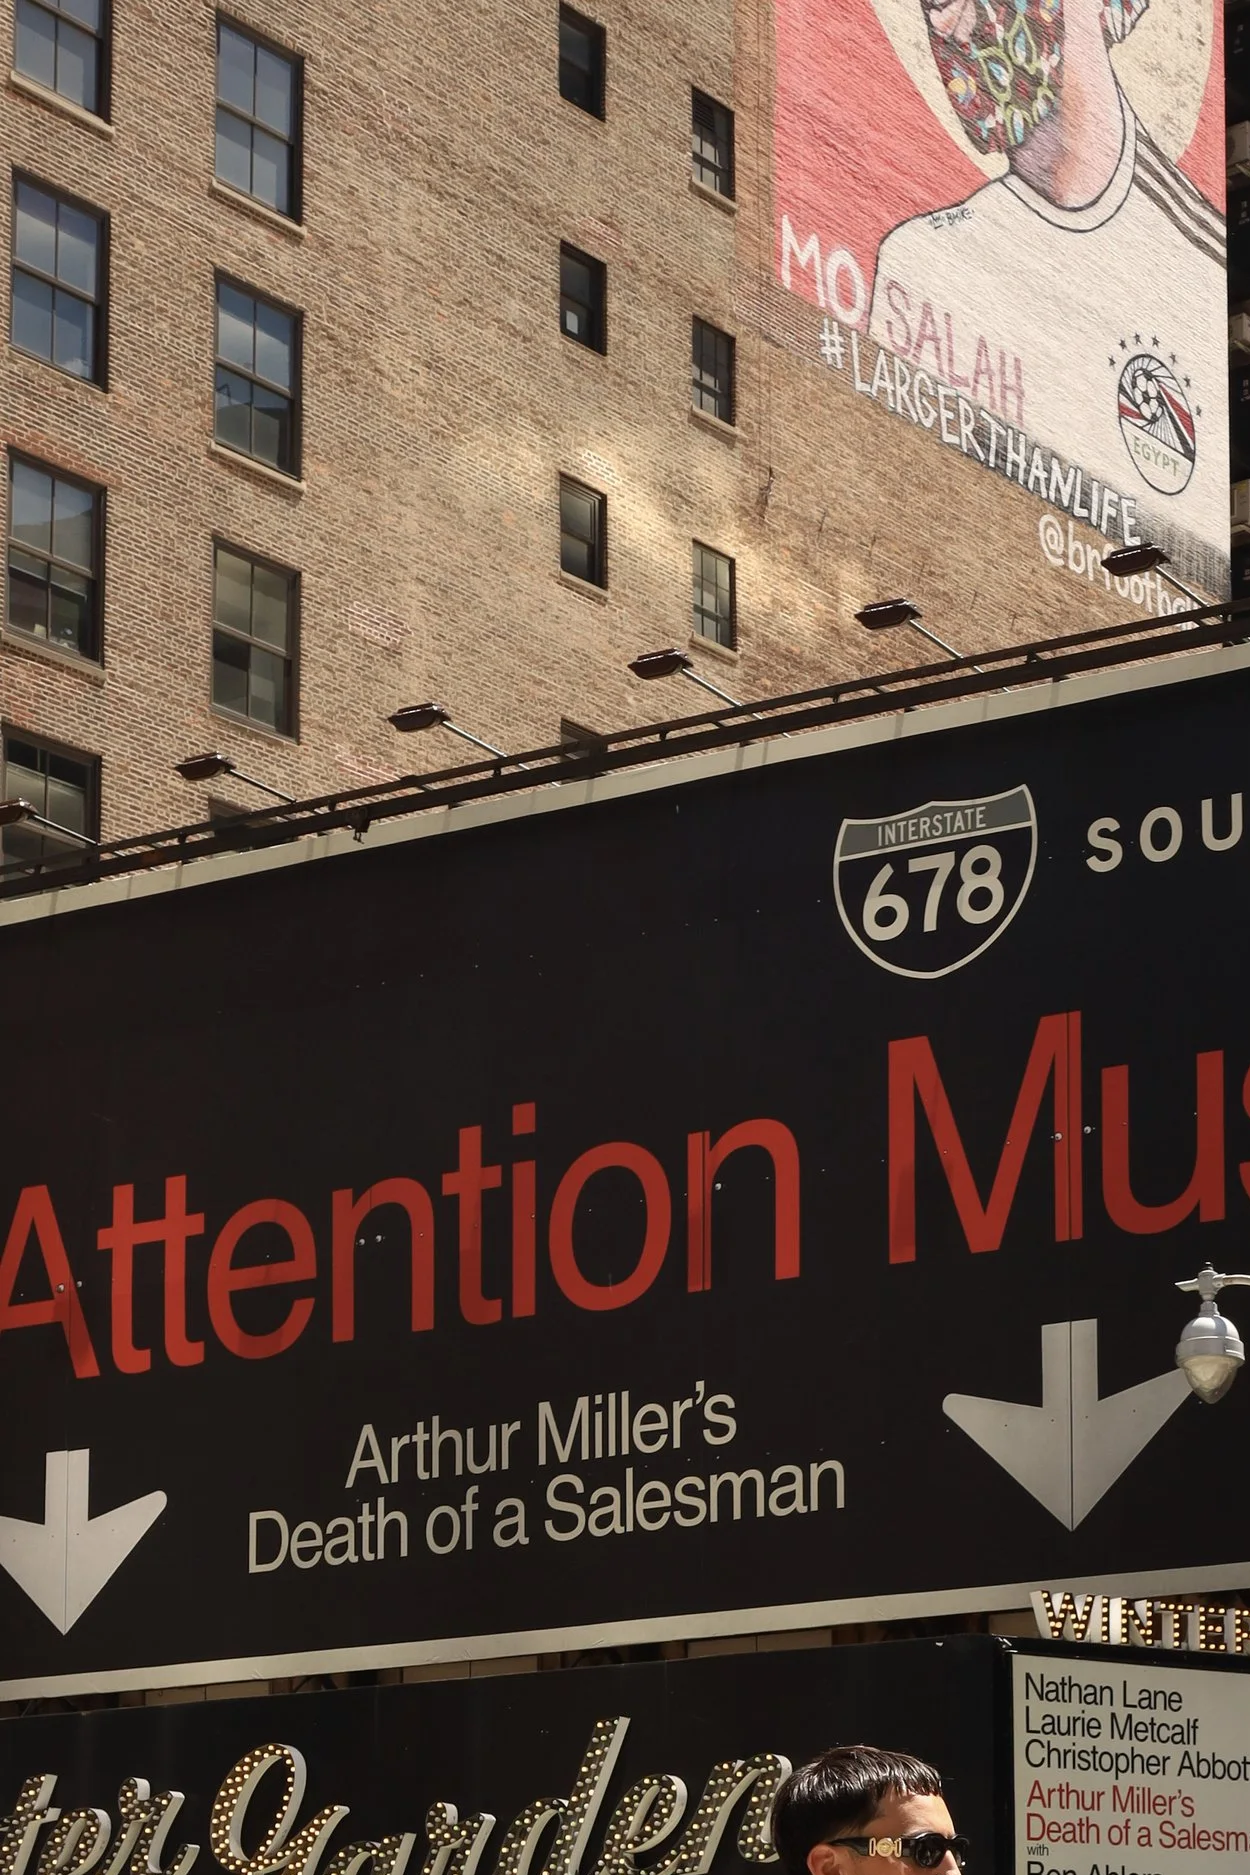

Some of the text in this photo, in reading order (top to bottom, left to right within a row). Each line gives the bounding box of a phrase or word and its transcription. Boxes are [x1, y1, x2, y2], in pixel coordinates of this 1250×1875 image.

[780, 215, 1027, 427] MO SALAH
[819, 321, 1143, 546] #LARGERTHANLIFE
[1132, 434, 1180, 477] EGYPT
[877, 805, 987, 848] INTERSTATE
[862, 844, 1005, 941] 678
[0, 1102, 801, 1380] Attention
[345, 1381, 738, 1490] Arthur Miller's
[249, 1458, 846, 1574] Death of a Salesman
[1024, 1672, 1183, 1713] Nathan Lane
[1024, 1705, 1199, 1746] Laurie Metcalf
[1024, 1738, 1171, 1782] Christopher
[1027, 1780, 1195, 1818] Arthur Miller's
[1026, 1813, 1101, 1846] Death
[1107, 1816, 1131, 1849] of
[1137, 1826, 1153, 1848] a
[1027, 1843, 1050, 1857] with
